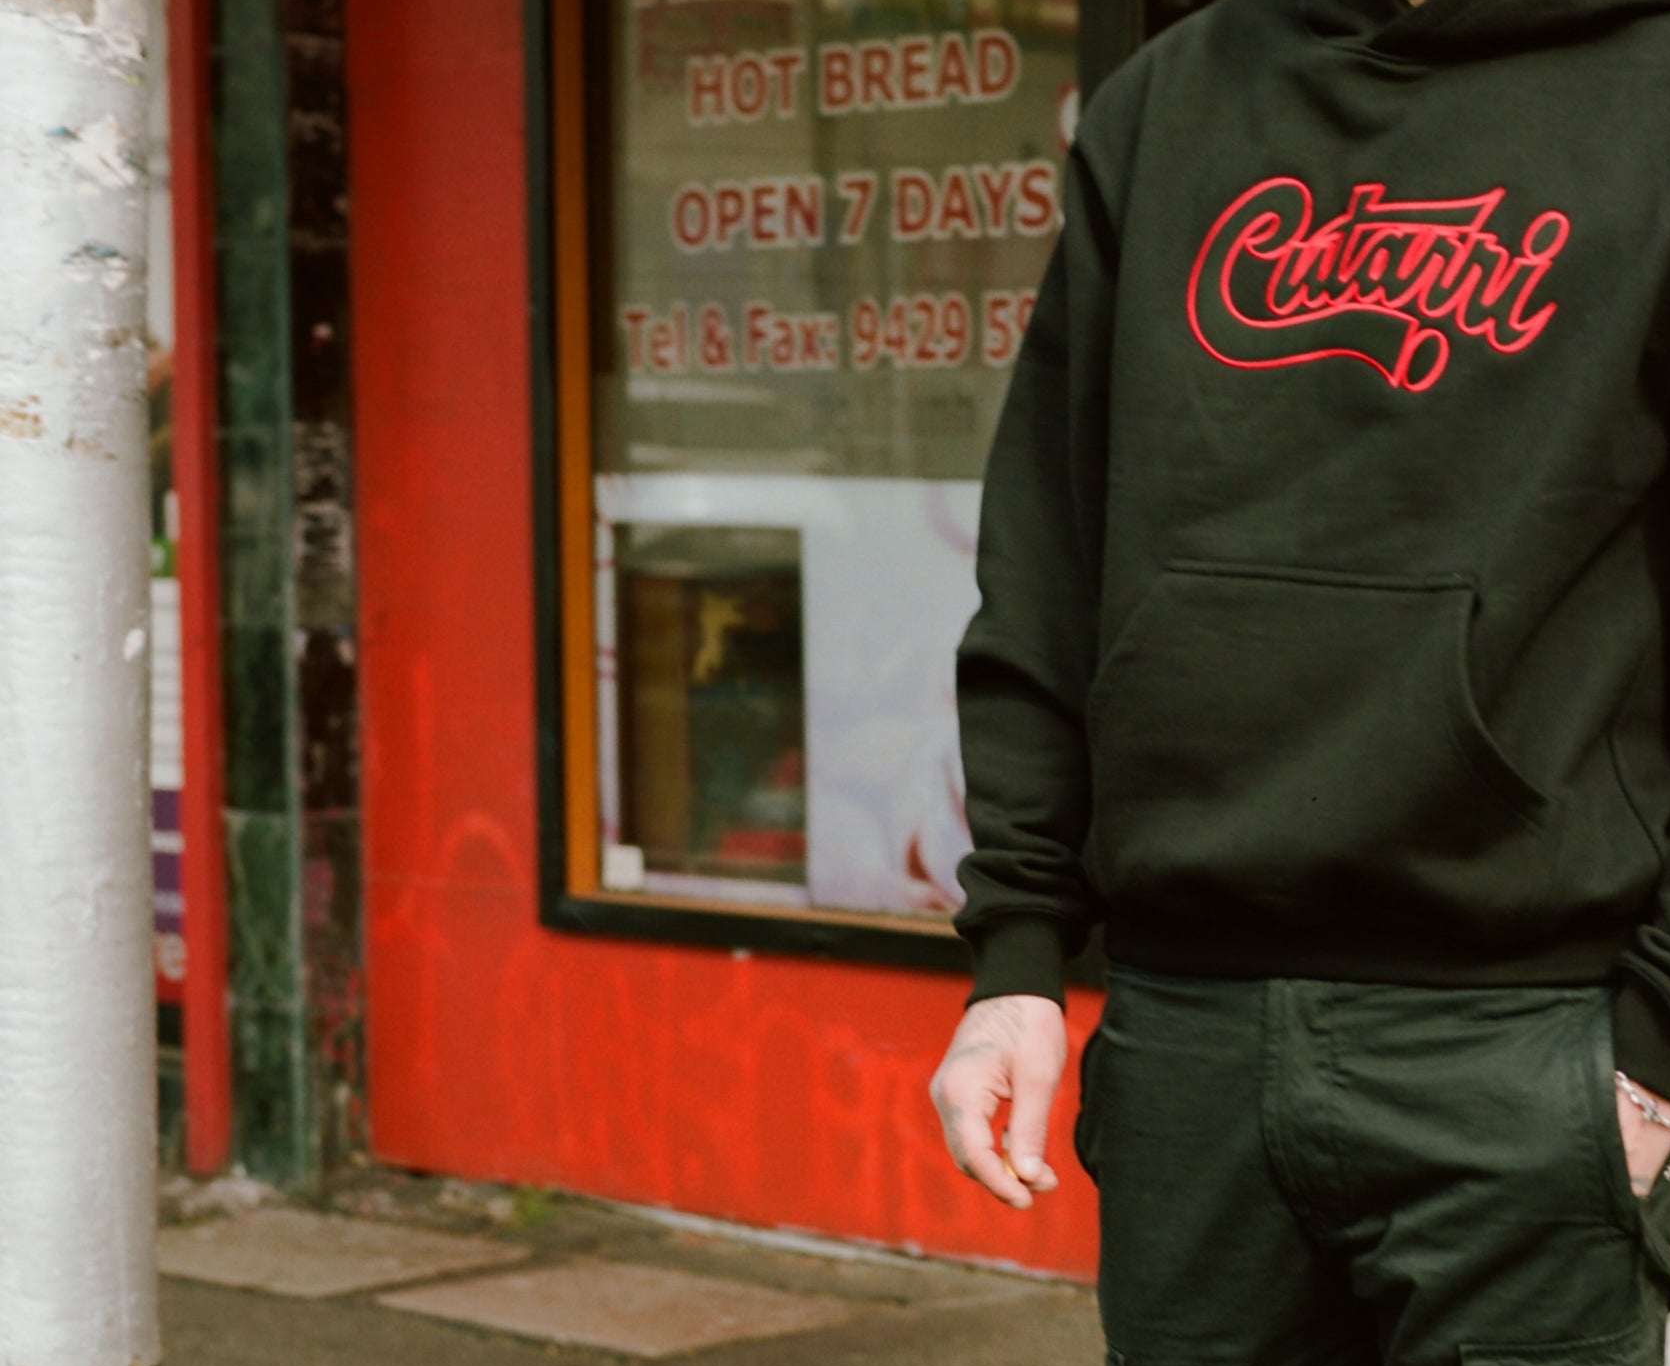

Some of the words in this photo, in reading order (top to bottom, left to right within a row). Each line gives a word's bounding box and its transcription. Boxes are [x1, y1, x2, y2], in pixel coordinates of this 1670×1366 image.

[688, 53, 802, 121] HOT
[820, 32, 1020, 110] BREAD
[673, 181, 821, 248] OPEN
[840, 178, 876, 239] 7
[895, 165, 1057, 235] DAYS
[622, 305, 688, 371] Tel
[700, 308, 732, 369] &
[746, 305, 839, 369] Fax:
[851, 296, 970, 367] 9429
